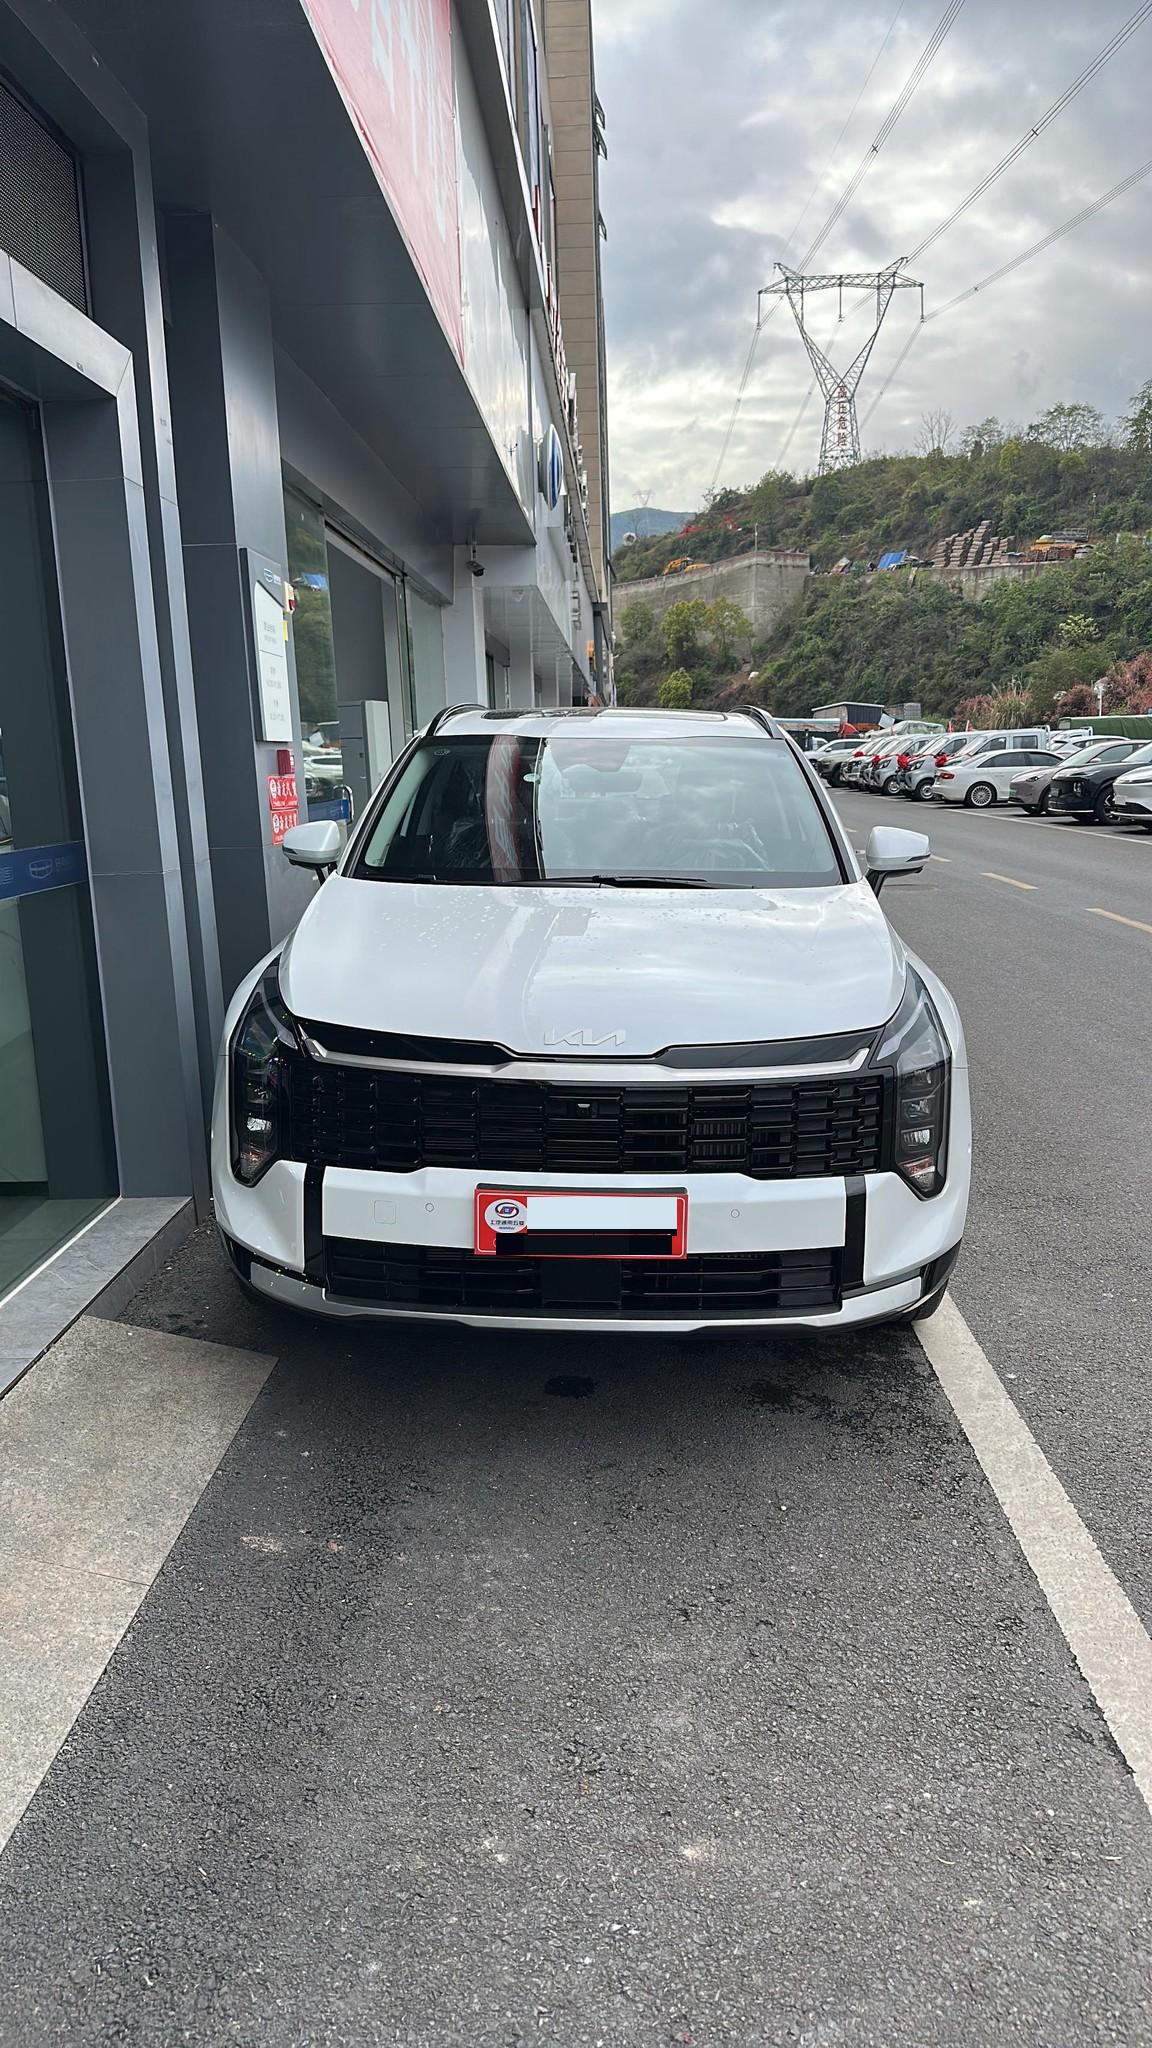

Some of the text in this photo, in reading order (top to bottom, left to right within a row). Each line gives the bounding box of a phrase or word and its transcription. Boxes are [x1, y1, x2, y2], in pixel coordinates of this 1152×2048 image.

[838, 385, 848, 446] 高压危险
[543, 1029, 626, 1046] KIA
